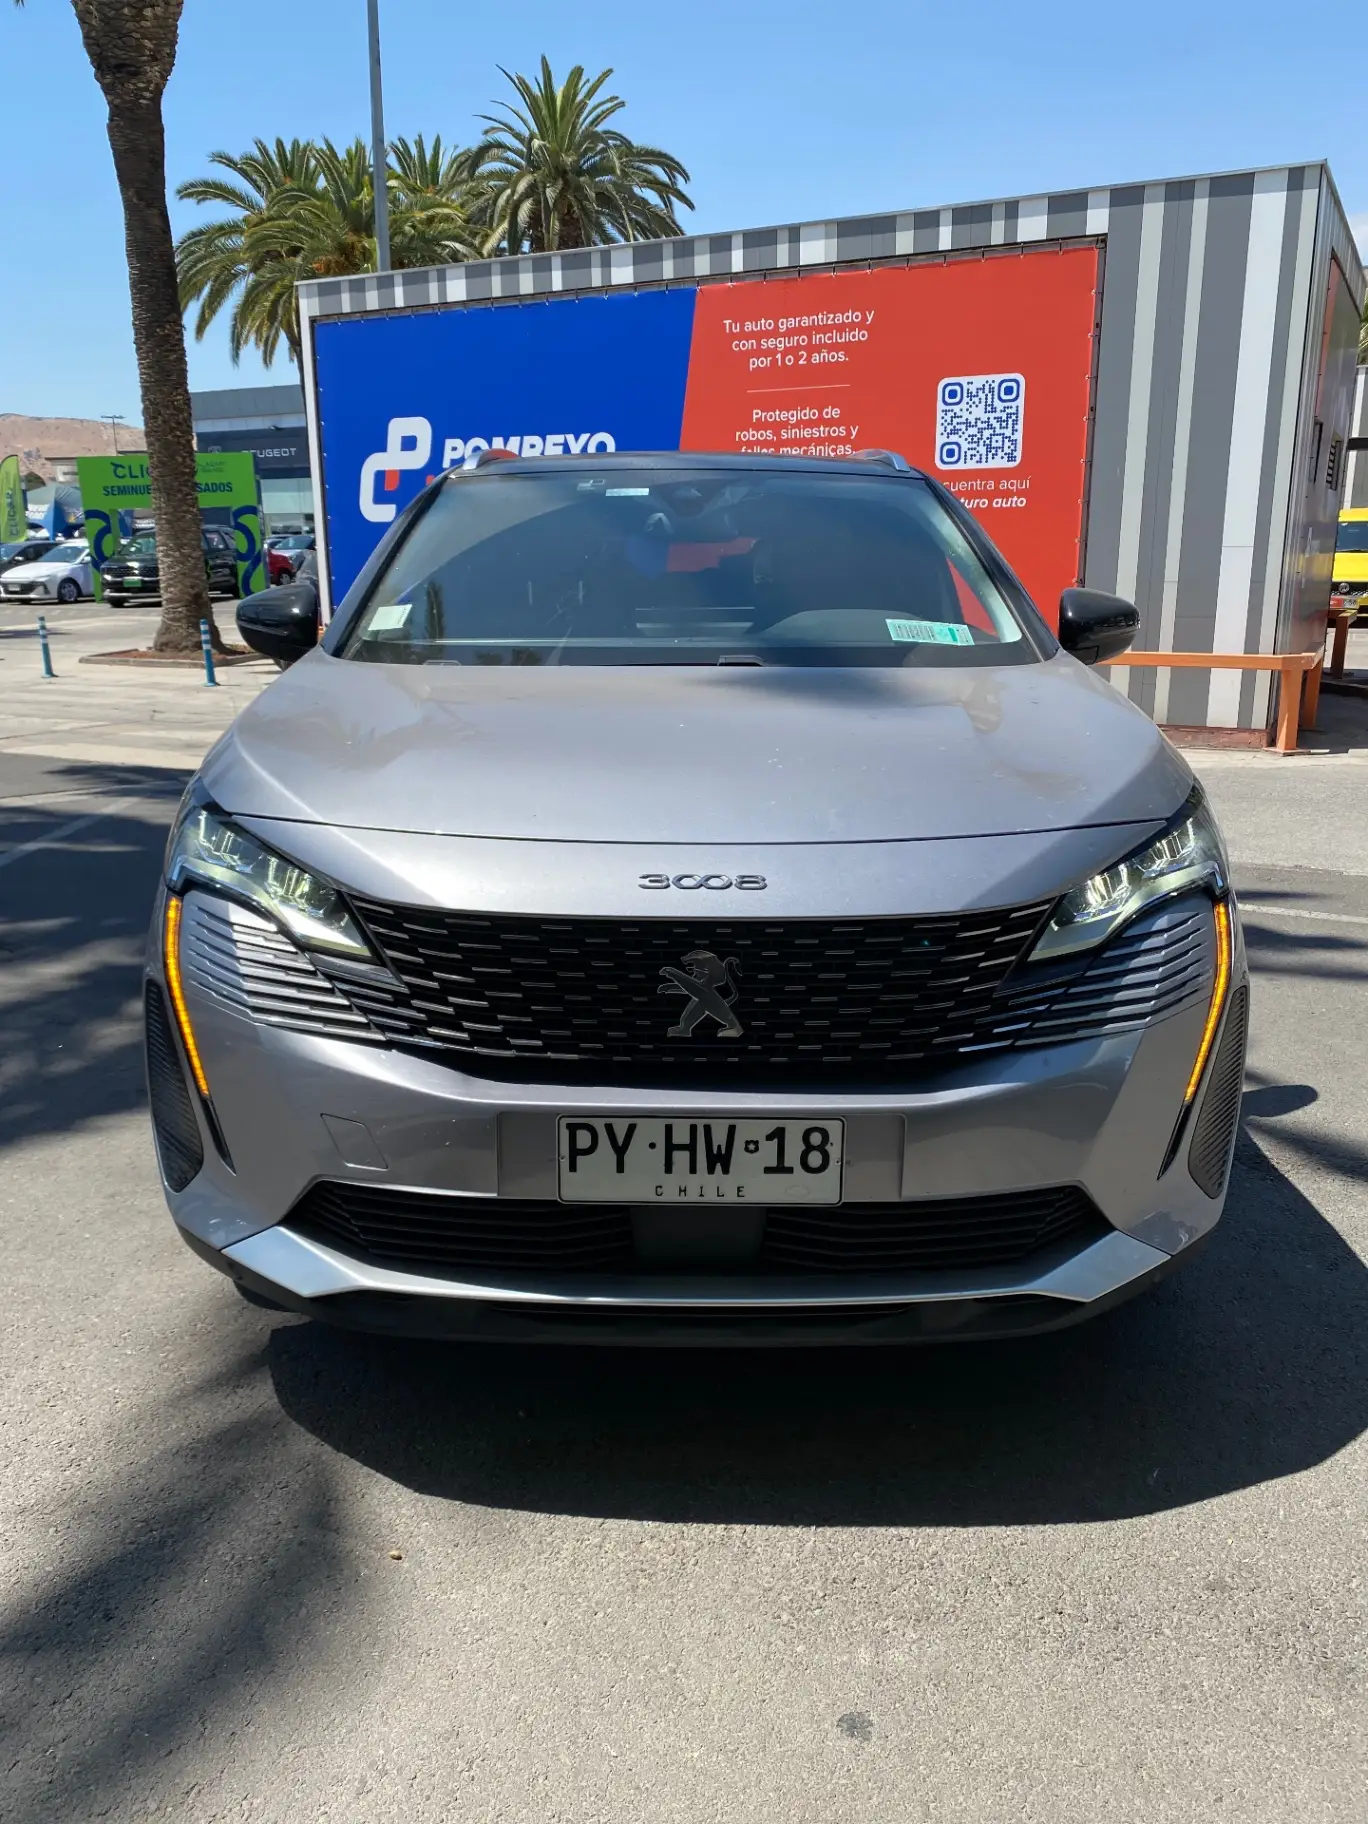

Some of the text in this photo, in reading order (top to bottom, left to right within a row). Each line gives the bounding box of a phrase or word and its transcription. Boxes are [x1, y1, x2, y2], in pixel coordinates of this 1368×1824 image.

[723, 309, 875, 333] Tu auto garantizado y
[732, 328, 868, 351] con seguro incluido
[749, 349, 849, 371] por 1 o 2 años.
[752, 405, 841, 424] Protegido de
[735, 425, 859, 441] robos, siniestros y
[241, 447, 297, 458] UGEOT
[442, 431, 616, 469] POMPEYO
[110, 461, 151, 479] CLI
[102, 481, 233, 497] SEMINUE SADOS
[942, 475, 1032, 492] cuentra aquí
[960, 495, 1027, 509] turo auto
[637, 873, 769, 891] 3008
[655, 1185, 746, 1198] CHILE
